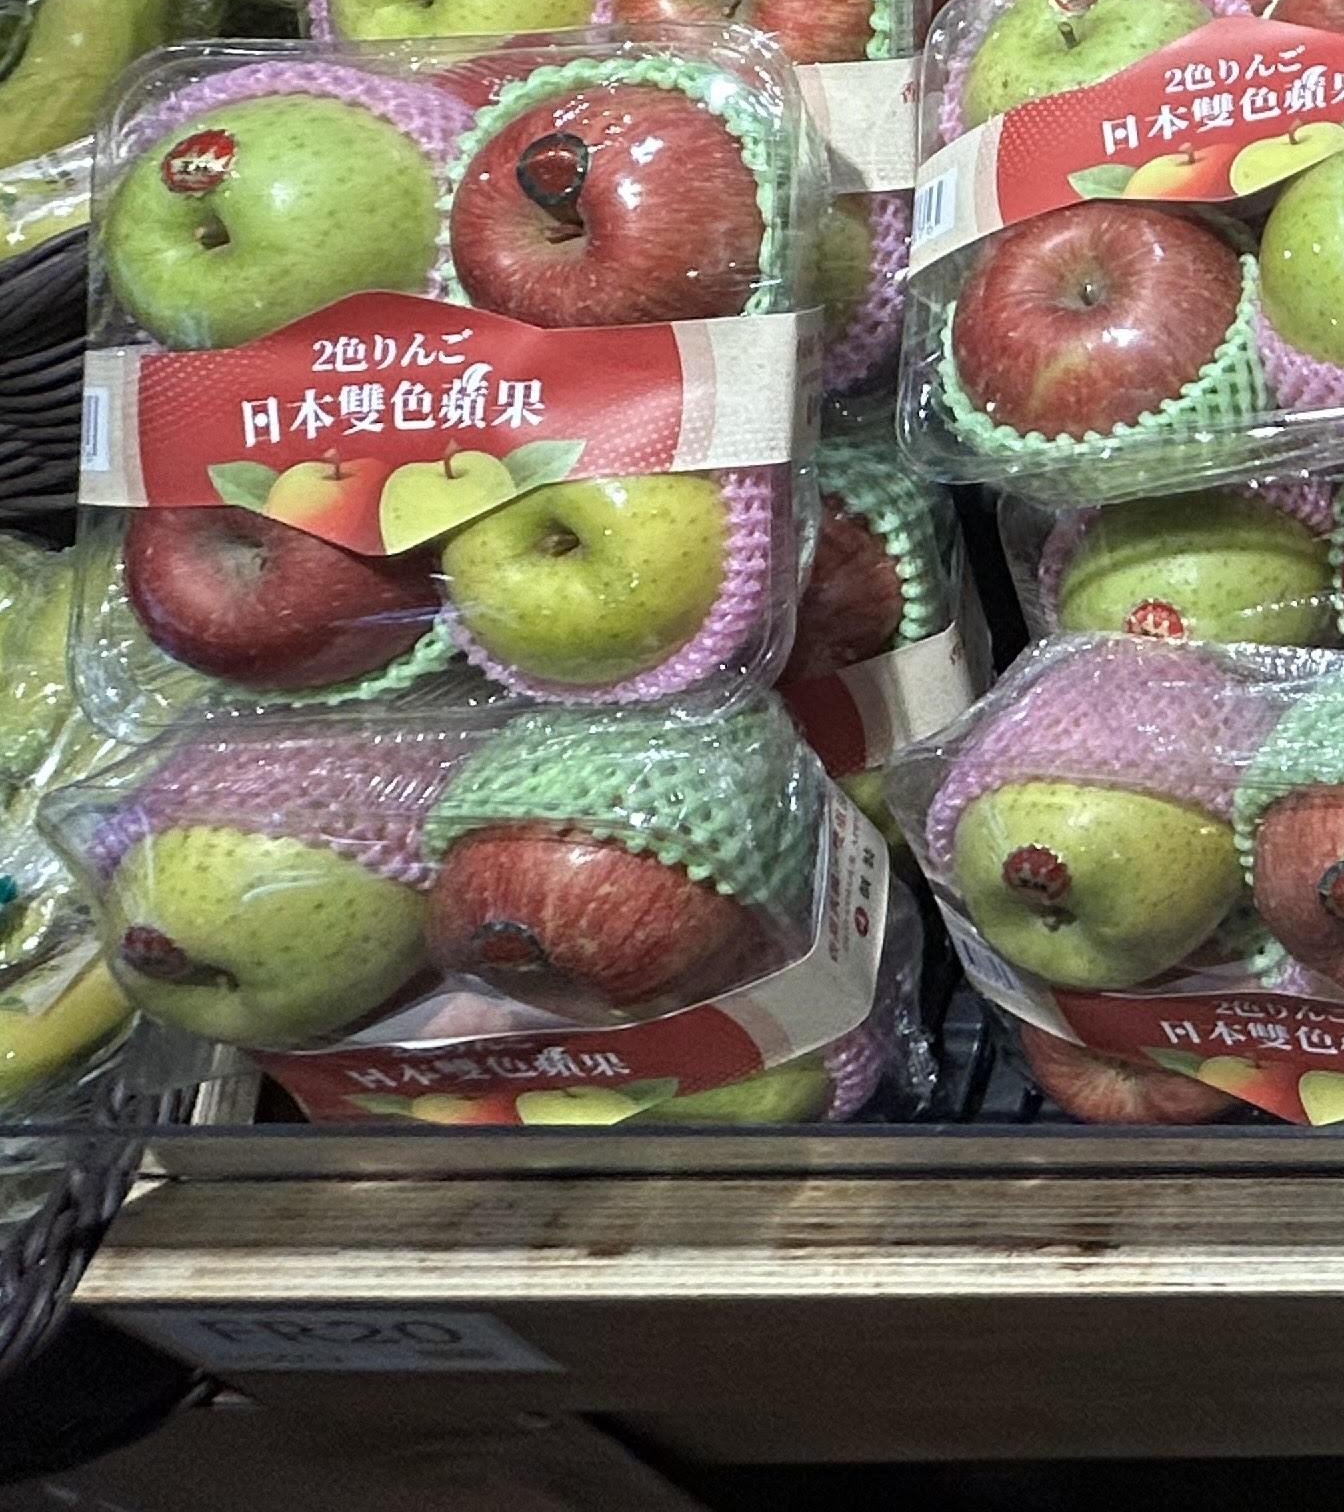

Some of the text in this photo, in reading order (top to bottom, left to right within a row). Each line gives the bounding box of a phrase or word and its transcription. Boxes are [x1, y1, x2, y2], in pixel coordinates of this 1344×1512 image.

[1164, 46, 1306, 94] 2色りんご
[312, 329, 474, 372] 2色りんご
[240, 363, 546, 447] 日本雙色蘋果
